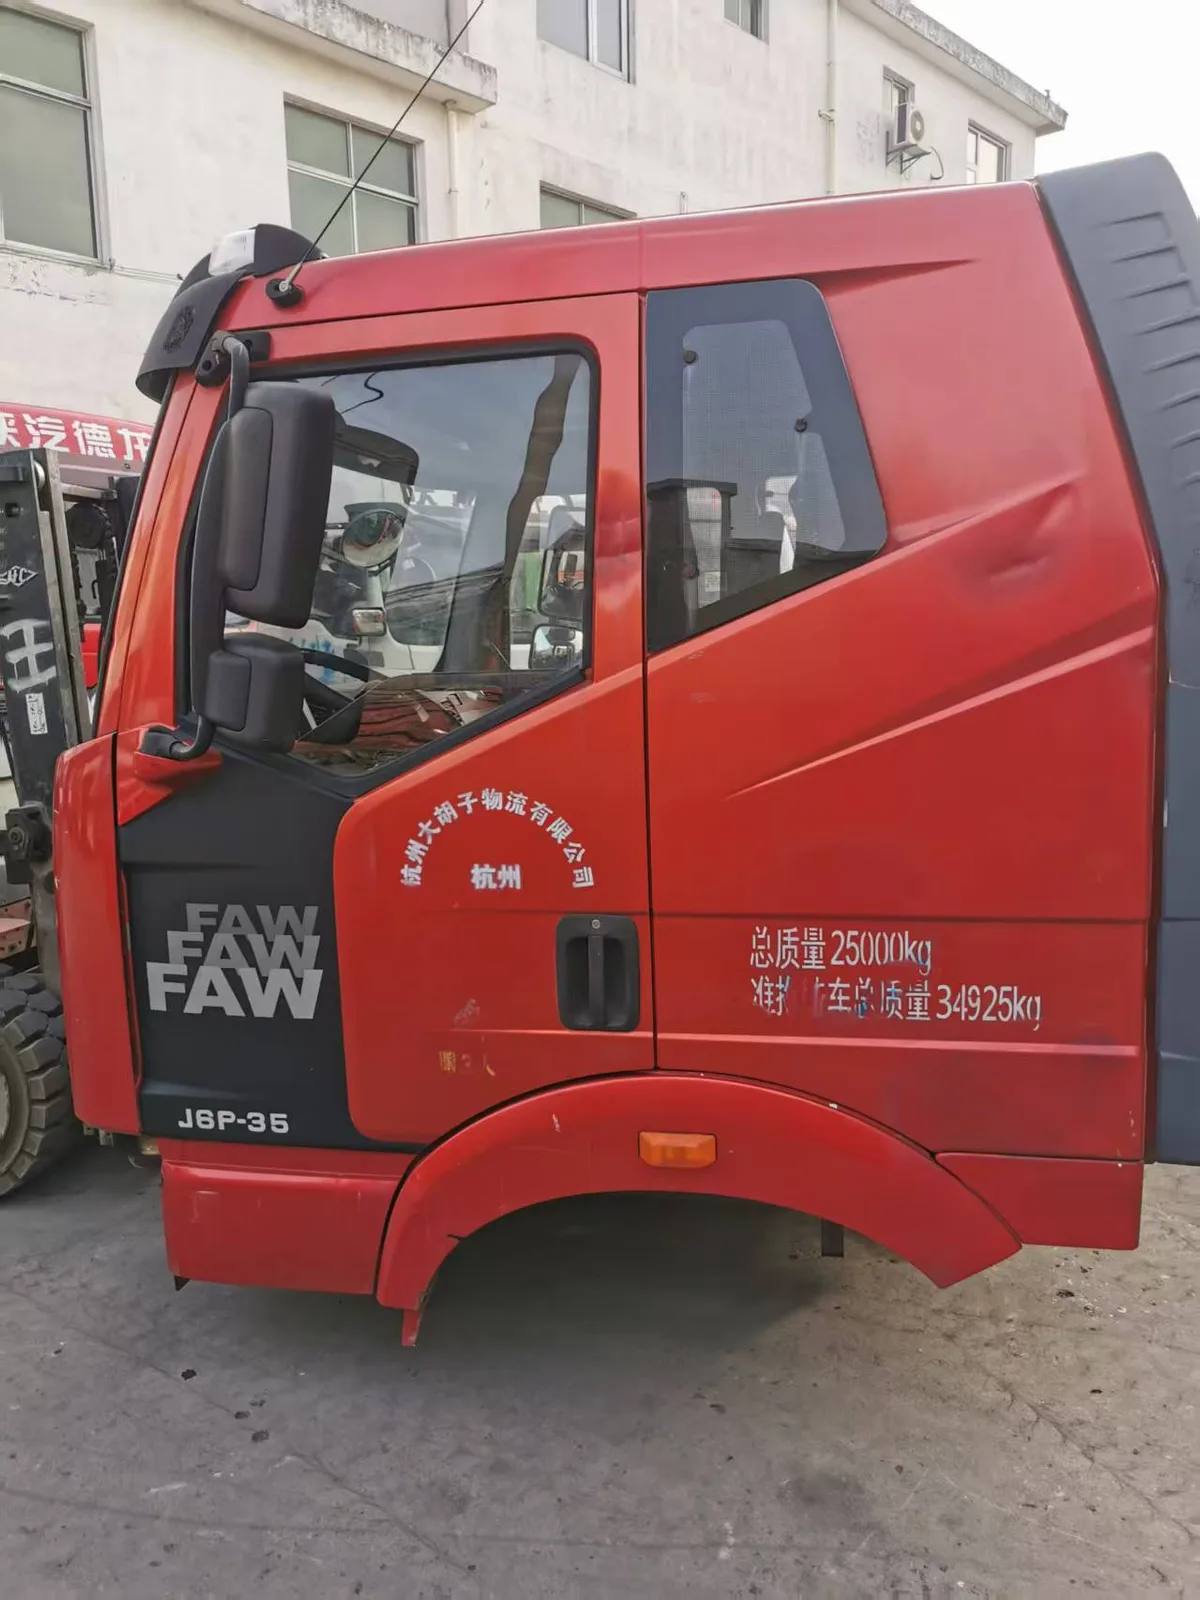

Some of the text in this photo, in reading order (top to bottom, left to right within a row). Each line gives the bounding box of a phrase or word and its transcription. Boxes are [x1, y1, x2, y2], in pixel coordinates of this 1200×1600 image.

[400, 788, 594, 888] 杭州大胡子物流有限公司
[470, 864, 521, 889] 杭州
[186, 903, 318, 942] FAW
[167, 930, 321, 978] FAW
[146, 961, 323, 1019] FAW
[178, 1108, 289, 1134] J6P-35
